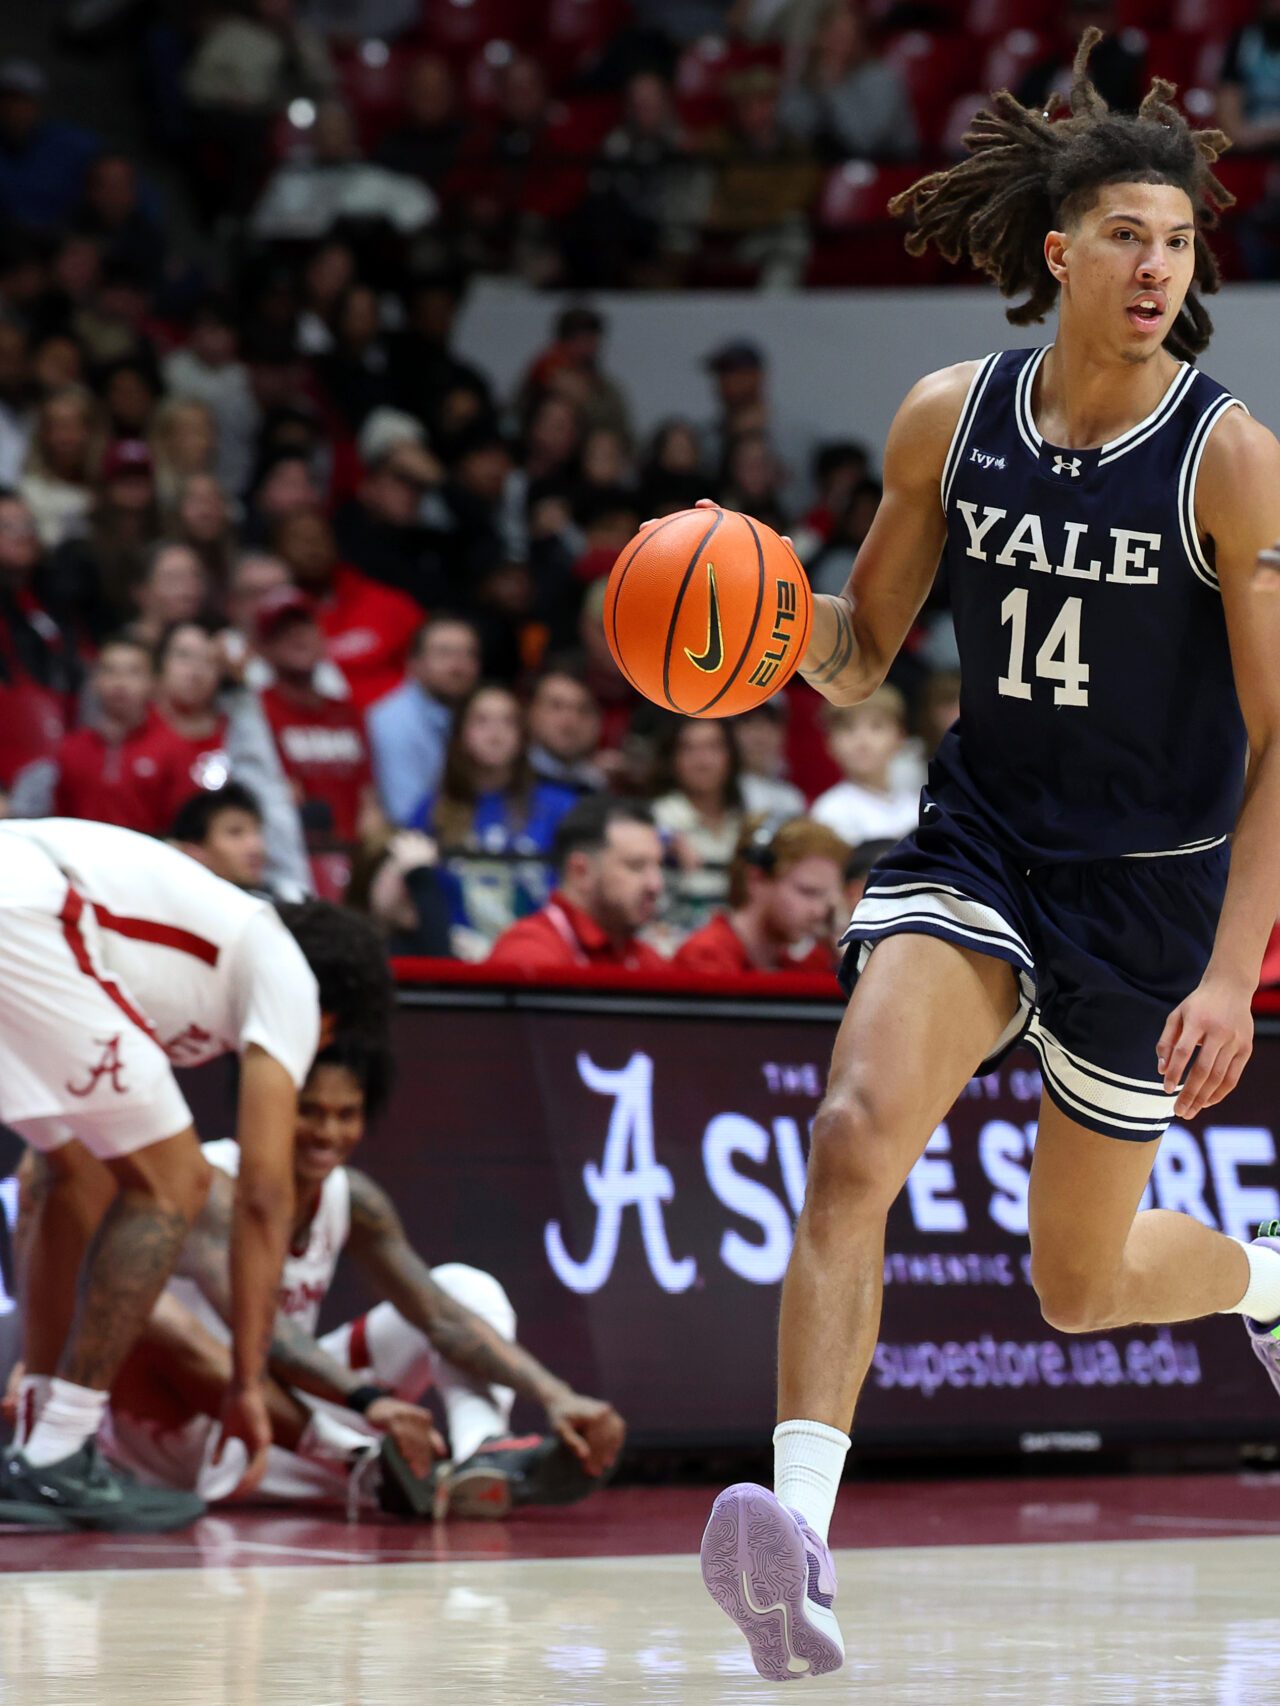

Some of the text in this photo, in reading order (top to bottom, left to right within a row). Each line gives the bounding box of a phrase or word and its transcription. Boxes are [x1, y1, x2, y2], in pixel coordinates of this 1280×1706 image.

[969, 448, 996, 468] Ivy
[956, 499, 1162, 585] YALE
[747, 578, 796, 688] ELITE
[998, 587, 1090, 707] 14
[762, 1062, 820, 1097] THE
[884, 1253, 1015, 1286] THENTIC
[872, 1327, 1201, 1398] supestore.ua.edu
